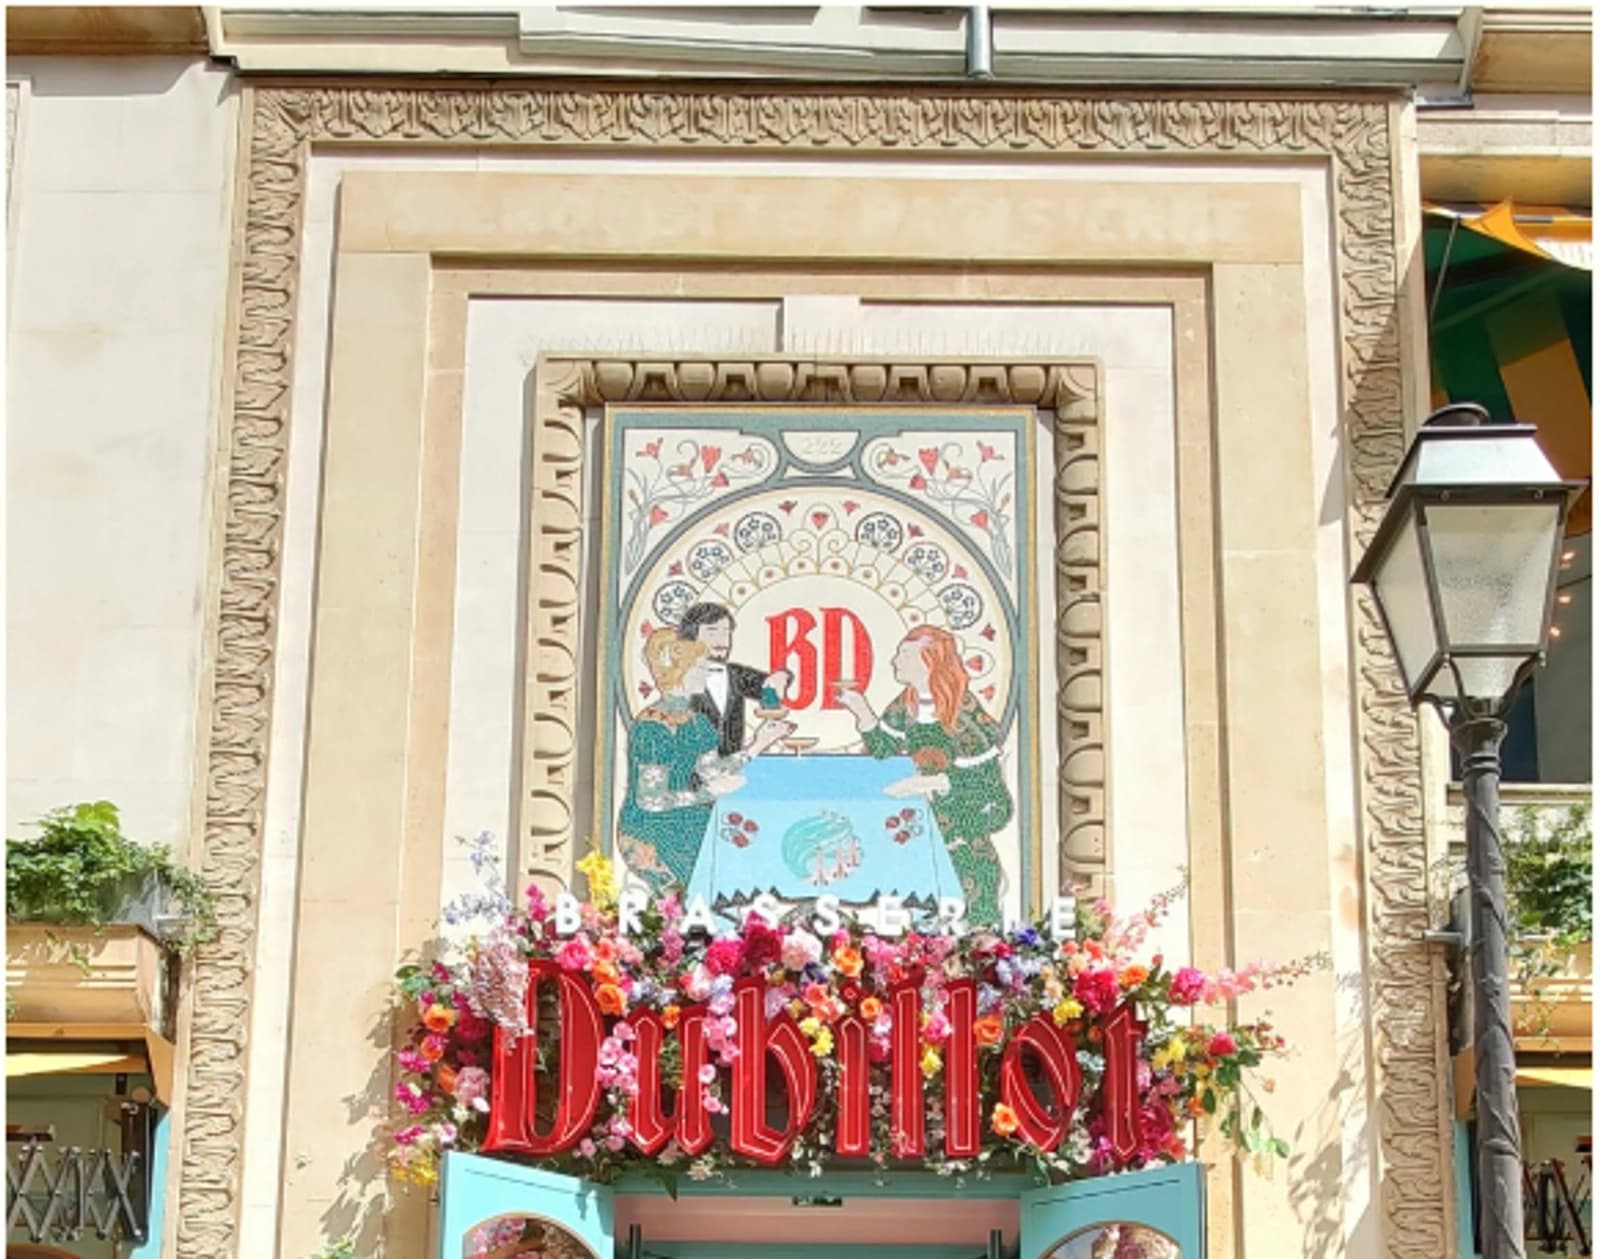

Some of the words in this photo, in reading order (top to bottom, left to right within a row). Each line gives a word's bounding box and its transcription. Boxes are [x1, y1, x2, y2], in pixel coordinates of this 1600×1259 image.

[765, 607, 874, 711] BD
[555, 892, 1076, 941] BRASSERIE
[481, 958, 1148, 1163] Dubillot
